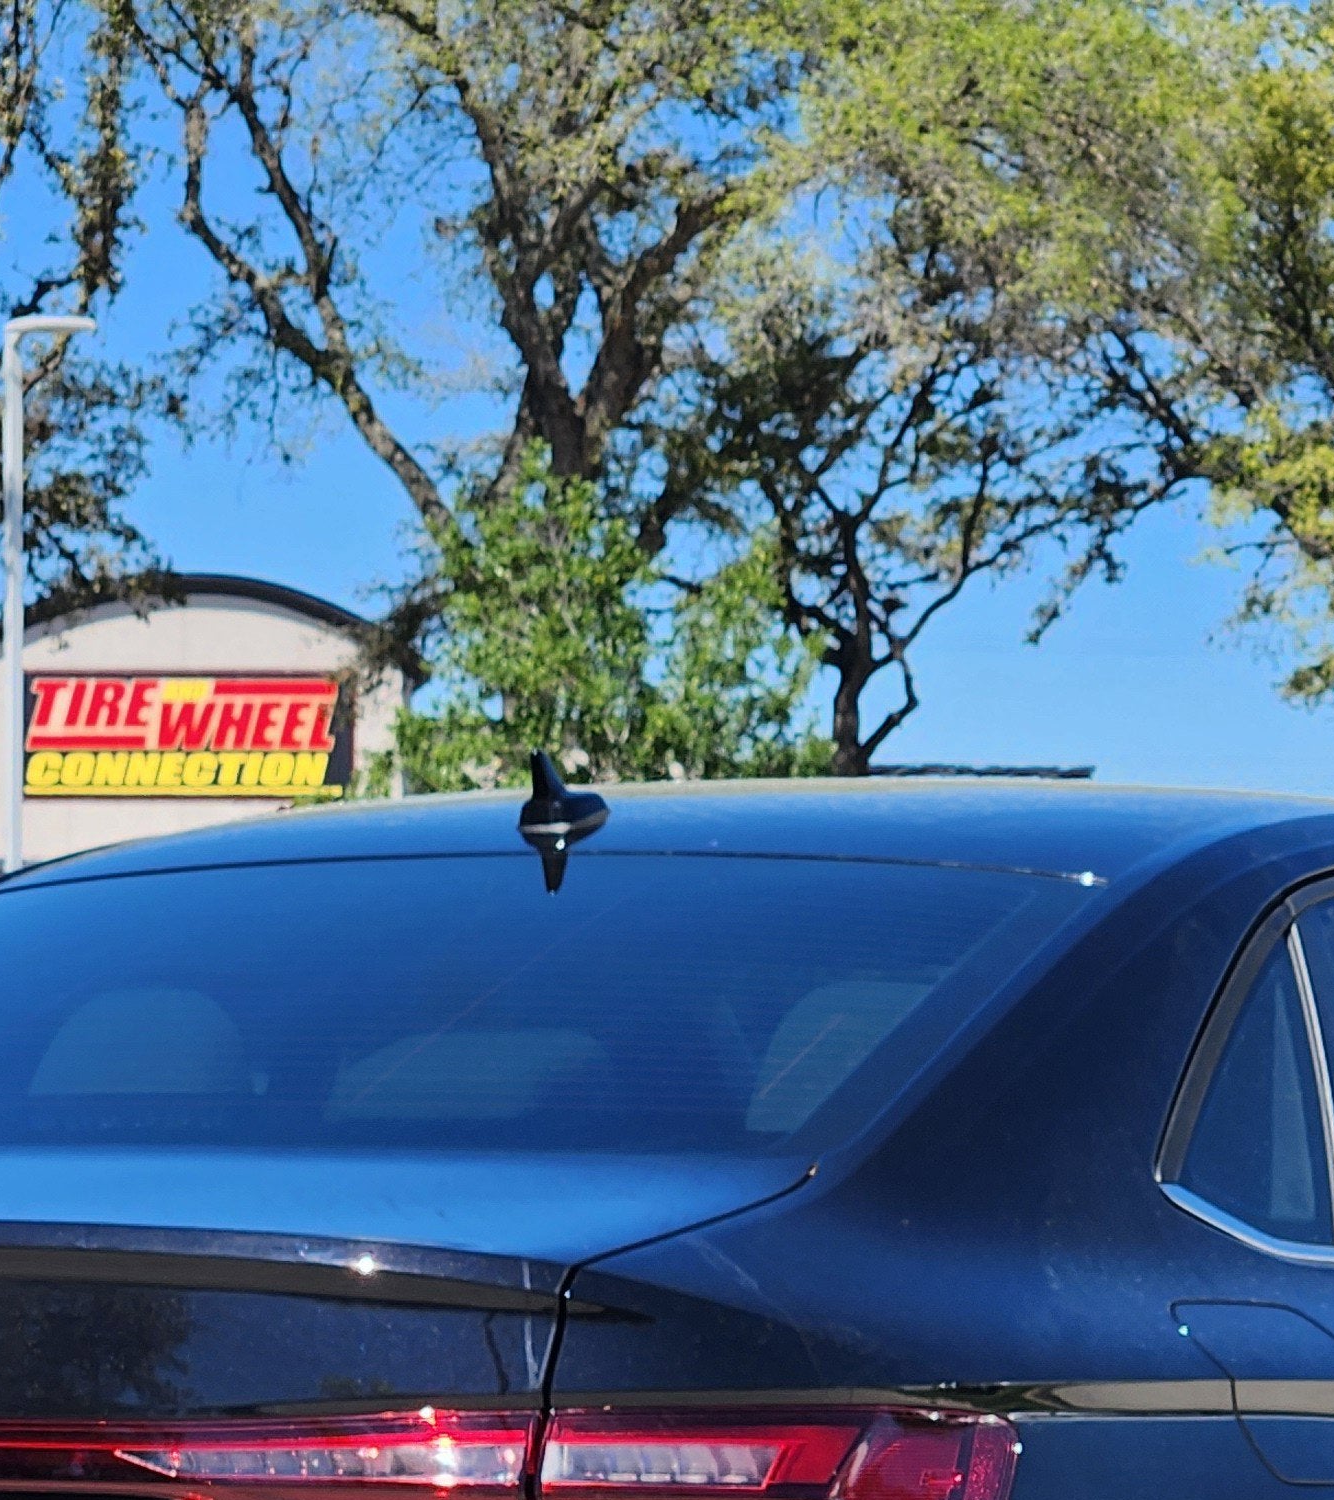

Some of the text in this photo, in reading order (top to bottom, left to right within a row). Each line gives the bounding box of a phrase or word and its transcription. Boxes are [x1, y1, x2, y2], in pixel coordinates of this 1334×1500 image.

[35, 680, 158, 727] TIRE
[157, 703, 334, 749] WHEEL
[25, 751, 329, 786] CONNECTION
